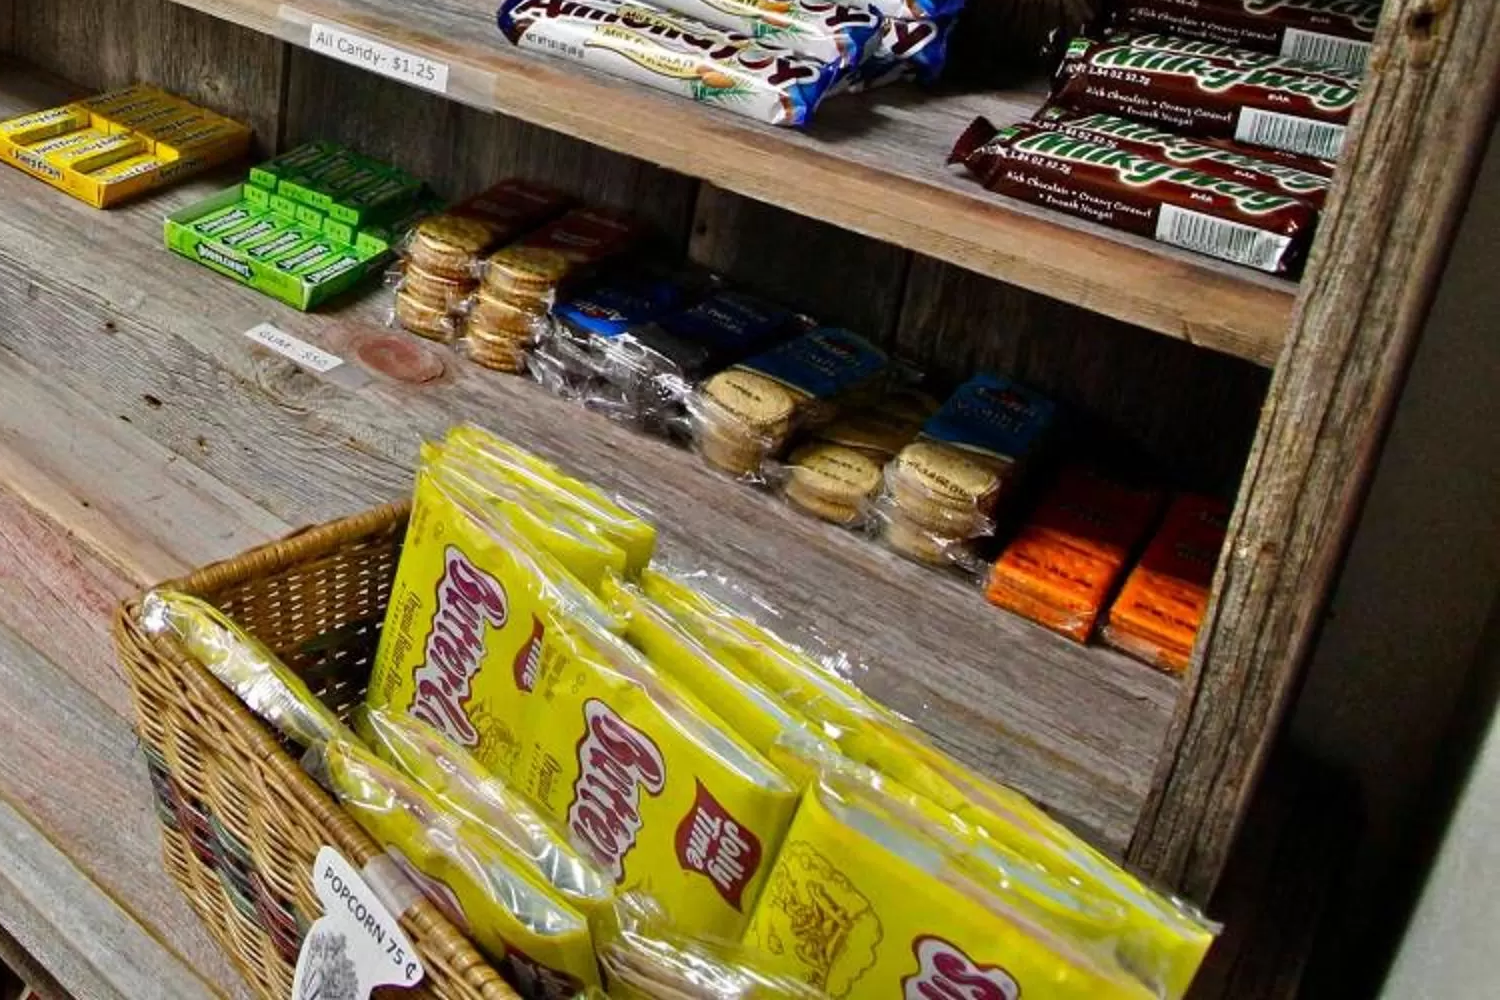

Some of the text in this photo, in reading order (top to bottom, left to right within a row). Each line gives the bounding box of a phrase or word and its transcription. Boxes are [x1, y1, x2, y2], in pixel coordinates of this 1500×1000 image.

[316, 32, 436, 82] All Candy- $1.25
[1091, 46, 1244, 93] Milky
[1240, 68, 1360, 112] Way
[1014, 131, 1302, 215] Milky Way
[1113, 200, 1152, 218] Caramel
[685, 807, 725, 870] Time
[706, 819, 751, 891] Jolly
[323, 866, 387, 944] POPCORN
[386, 937, 406, 966] 75
